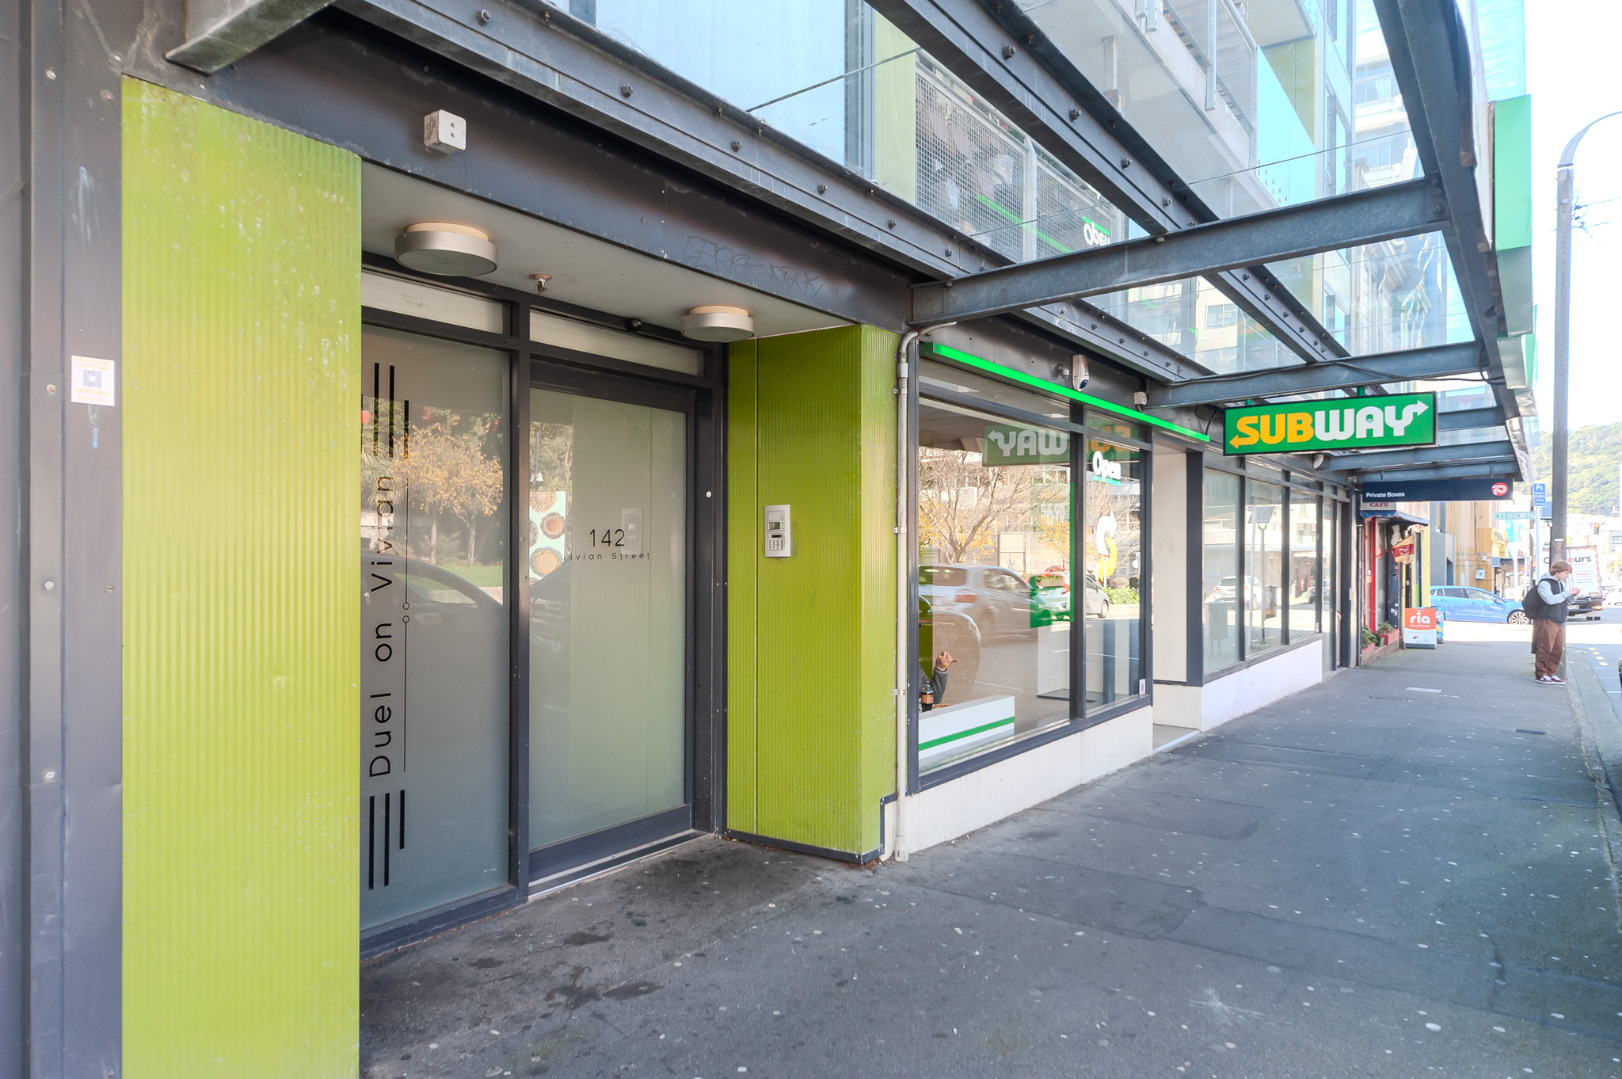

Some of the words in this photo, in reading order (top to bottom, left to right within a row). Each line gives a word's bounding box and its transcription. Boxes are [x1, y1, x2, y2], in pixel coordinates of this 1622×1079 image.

[1229, 400, 1429, 449] SUBWAY
[1092, 451, 1122, 482] Open
[371, 476, 394, 593] Vivian
[589, 529, 625, 547] 142
[1409, 611, 1431, 625] ria
[375, 622, 393, 663] on
[368, 692, 392, 778] Duel
